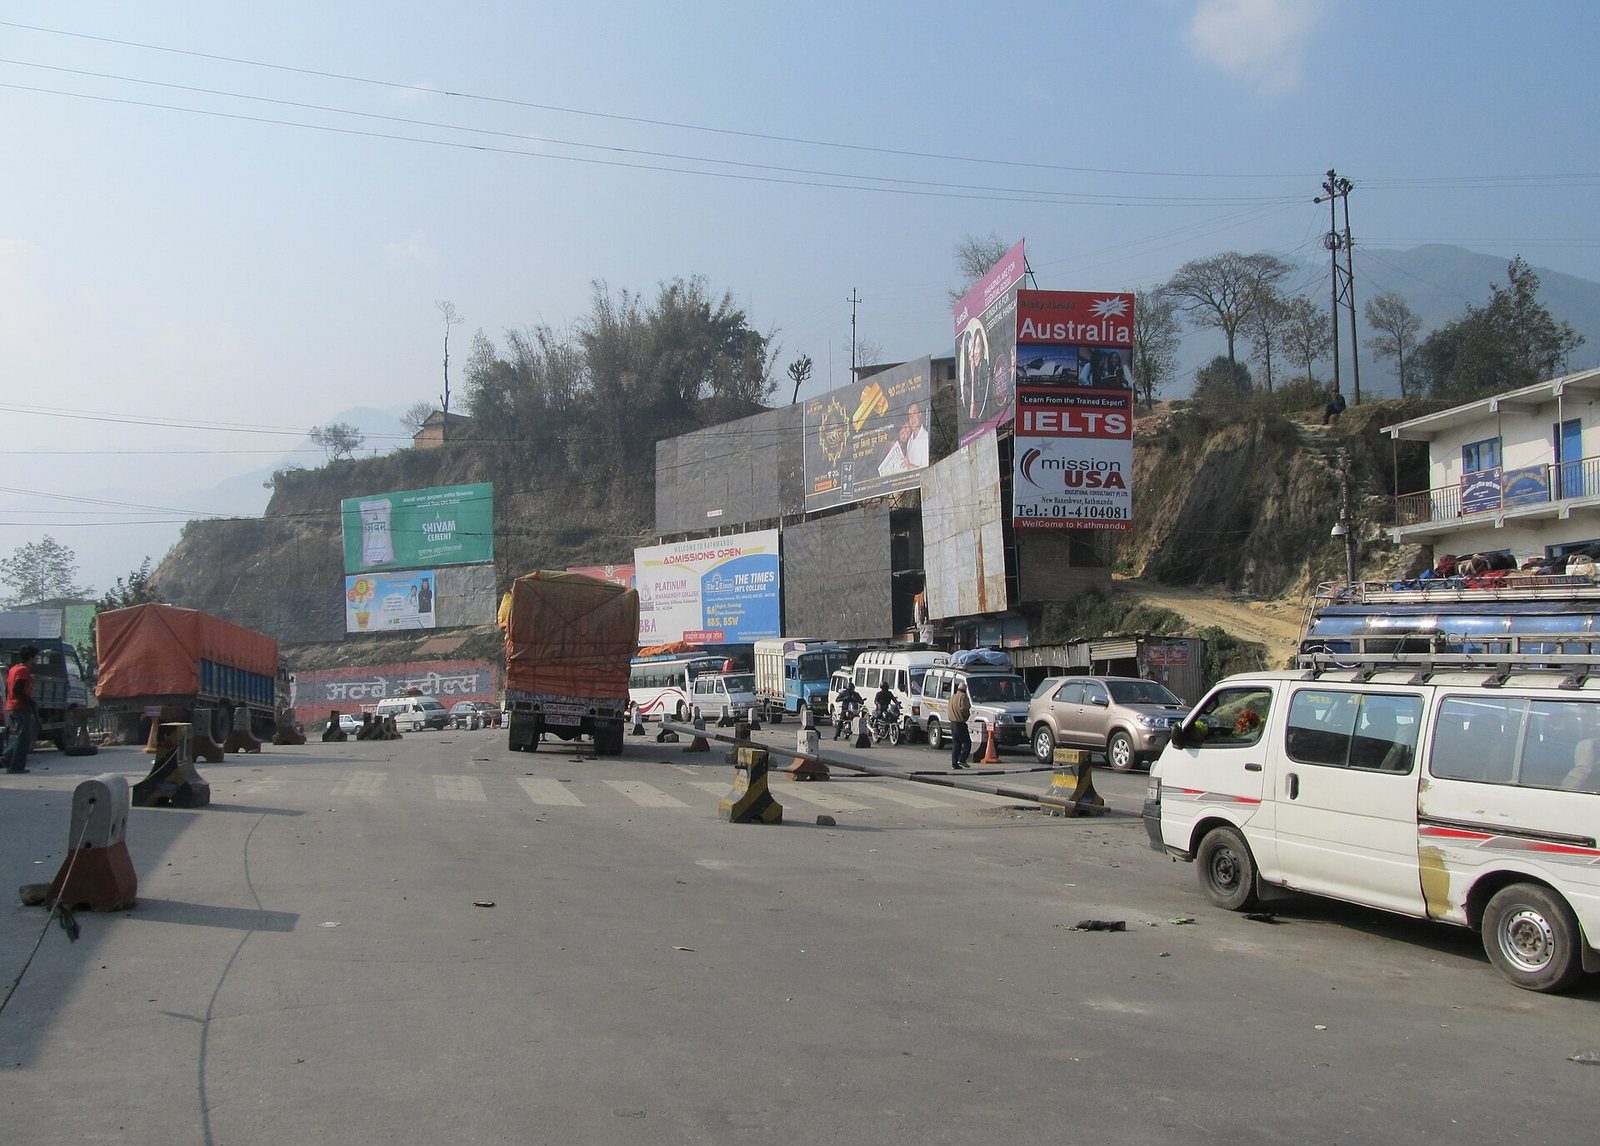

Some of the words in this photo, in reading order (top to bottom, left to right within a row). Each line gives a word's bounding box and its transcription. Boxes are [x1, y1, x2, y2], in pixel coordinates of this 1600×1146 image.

[1019, 318, 1130, 342] Australia
[1046, 396, 1063, 404] From
[1076, 397, 1100, 406] Trained
[1023, 411, 1127, 434] IELTS
[1041, 457, 1121, 471] mission
[1064, 470, 1126, 489] USA
[1016, 504, 1048, 517] Tel.:
[1052, 505, 1128, 519] 01-4104081
[422, 520, 456, 535] SHIVAM
[1022, 520, 1064, 529] WelCome
[1076, 521, 1126, 530] Kathmandu
[428, 532, 452, 542] CEMENT
[674, 543, 696, 553] WELCOME
[704, 539, 734, 549] KATHMANDU
[663, 550, 715, 565] ADMISSIONS
[717, 547, 742, 558] OPEN
[734, 573, 749, 585] THE
[751, 571, 775, 584] TIMES
[654, 580, 687, 592] PLATINUM
[745, 584, 767, 592] COLLEGE
[655, 591, 681, 600] MANAGEMENT
[681, 590, 699, 599] COLLEGE
